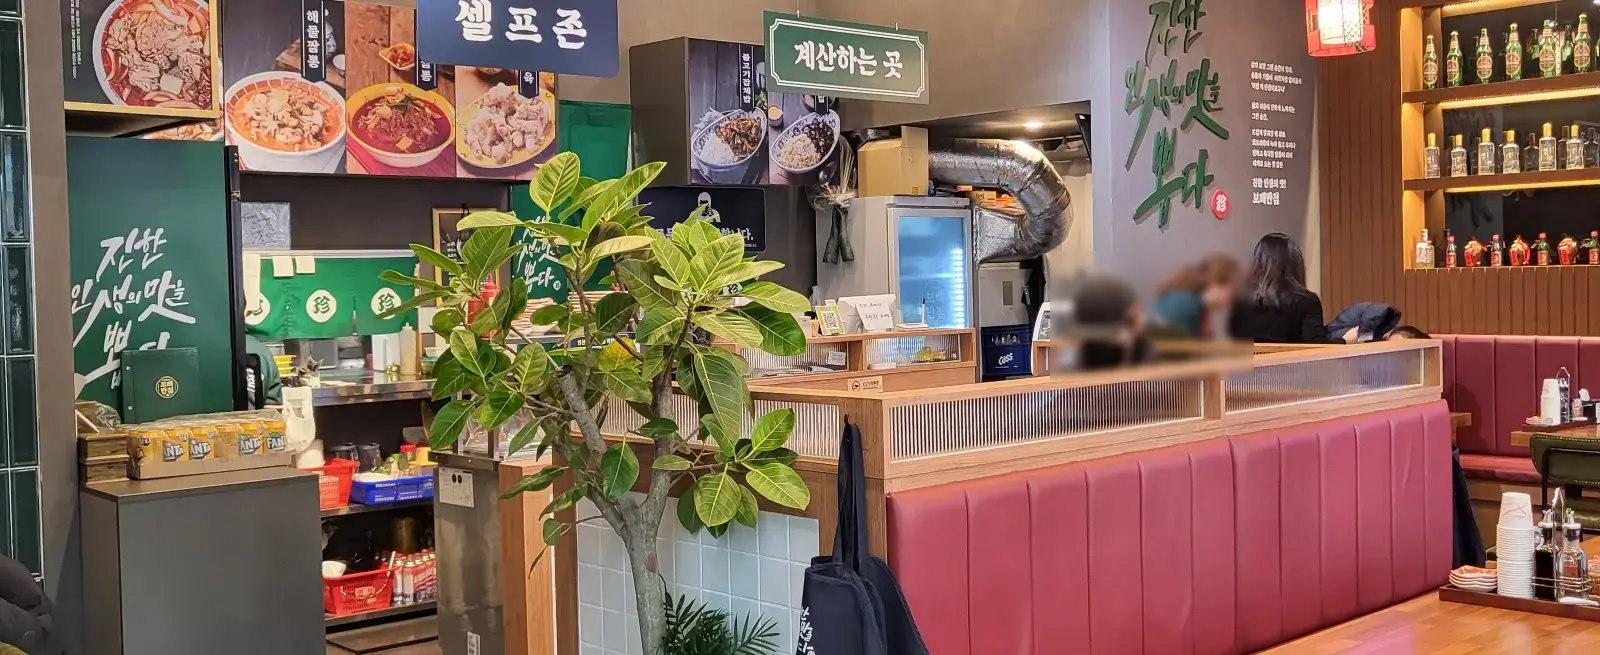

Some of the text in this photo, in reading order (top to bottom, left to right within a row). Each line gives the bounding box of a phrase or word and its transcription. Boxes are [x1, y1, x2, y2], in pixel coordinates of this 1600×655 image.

[306, 10, 320, 69] 해물짬뽕
[420, 60, 432, 82] 짬뽕
[794, 40, 903, 80] 계산하는 곳
[741, 52, 751, 104] 불고기잡채밥
[1252, 177, 1263, 188] 진한
[1264, 177, 1279, 189] 인생의
[1252, 191, 1280, 205] 보배반점
[96, 227, 167, 282] 진한
[138, 270, 196, 324] 맛을
[313, 295, 331, 314] 珍
[377, 293, 395, 312] 珍
[190, 442, 212, 456] ANTA
